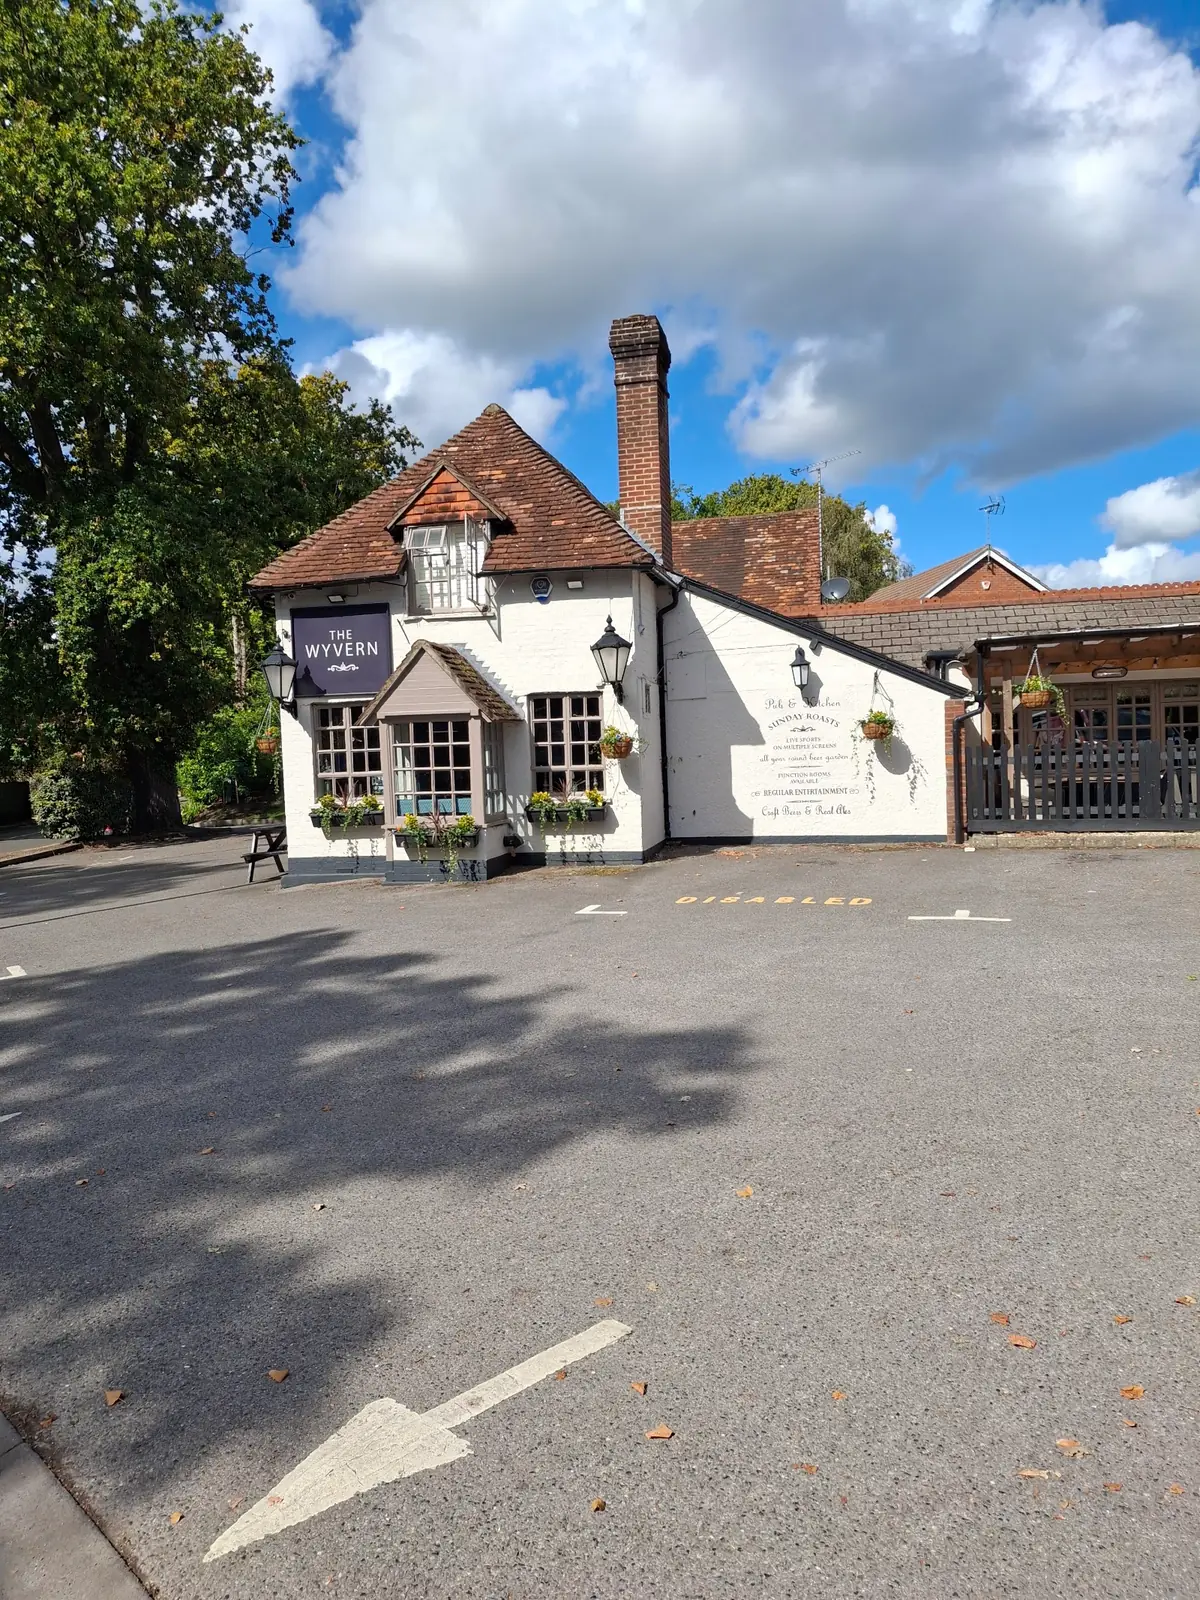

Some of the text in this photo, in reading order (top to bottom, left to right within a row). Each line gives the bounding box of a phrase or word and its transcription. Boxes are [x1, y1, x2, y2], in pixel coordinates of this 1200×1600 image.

[329, 630, 352, 640] THE
[305, 641, 378, 658] WYVERN
[764, 696, 841, 710] Pub & Kitchen
[768, 713, 840, 730] SUNDAY ROASTS
[825, 753, 848, 763] garden
[795, 788, 848, 796] ENTERTAINMENT
[762, 804, 851, 820] Craft Beers & Real Ales
[675, 896, 873, 905] DISABLED
